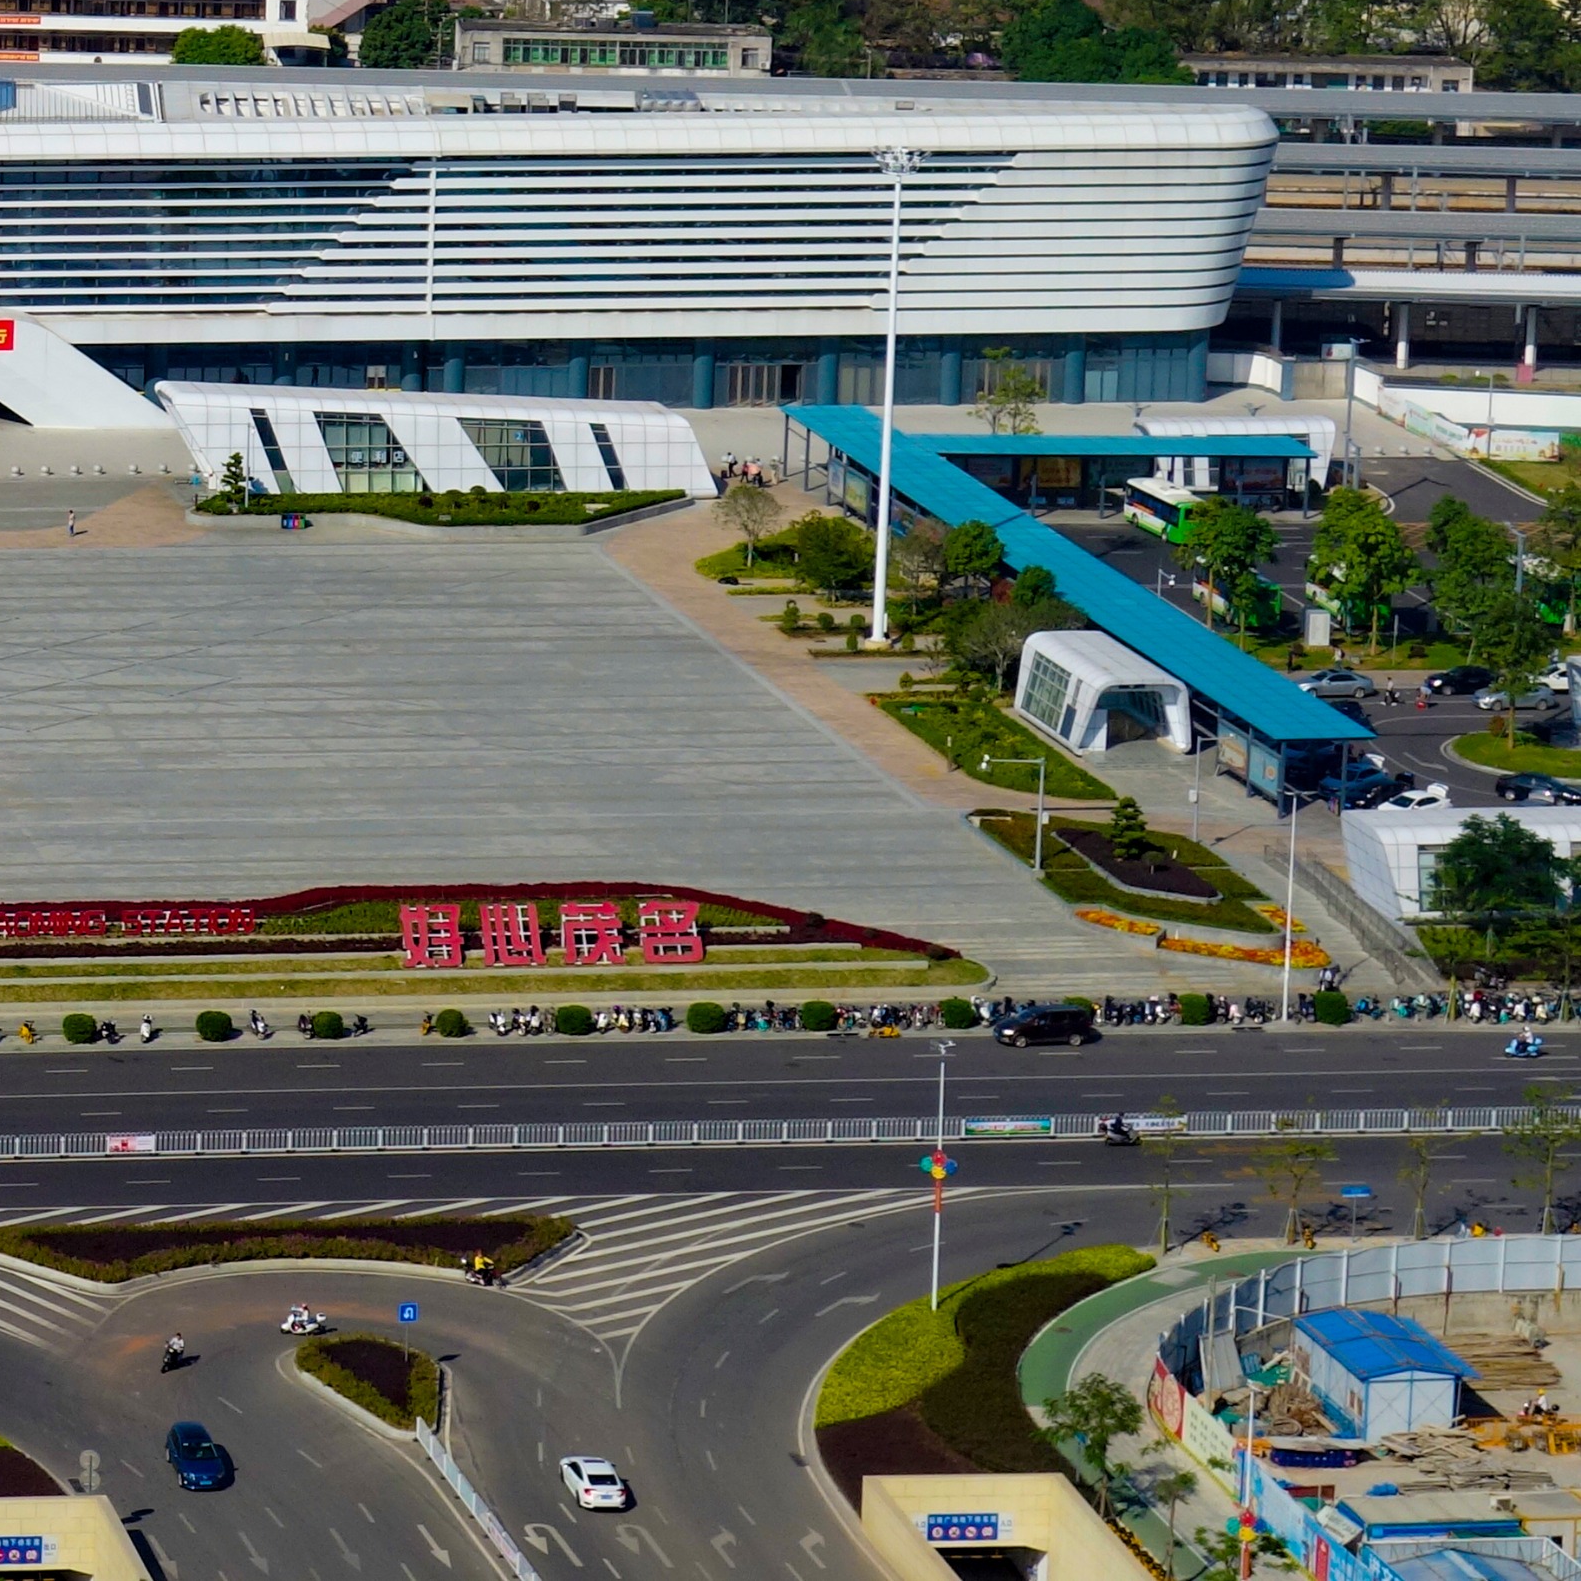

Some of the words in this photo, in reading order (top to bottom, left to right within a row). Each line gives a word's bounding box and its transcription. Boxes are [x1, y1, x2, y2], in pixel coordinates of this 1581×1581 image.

[350, 451, 405, 464] 便利店
[399, 898, 705, 969] 好心茂名
